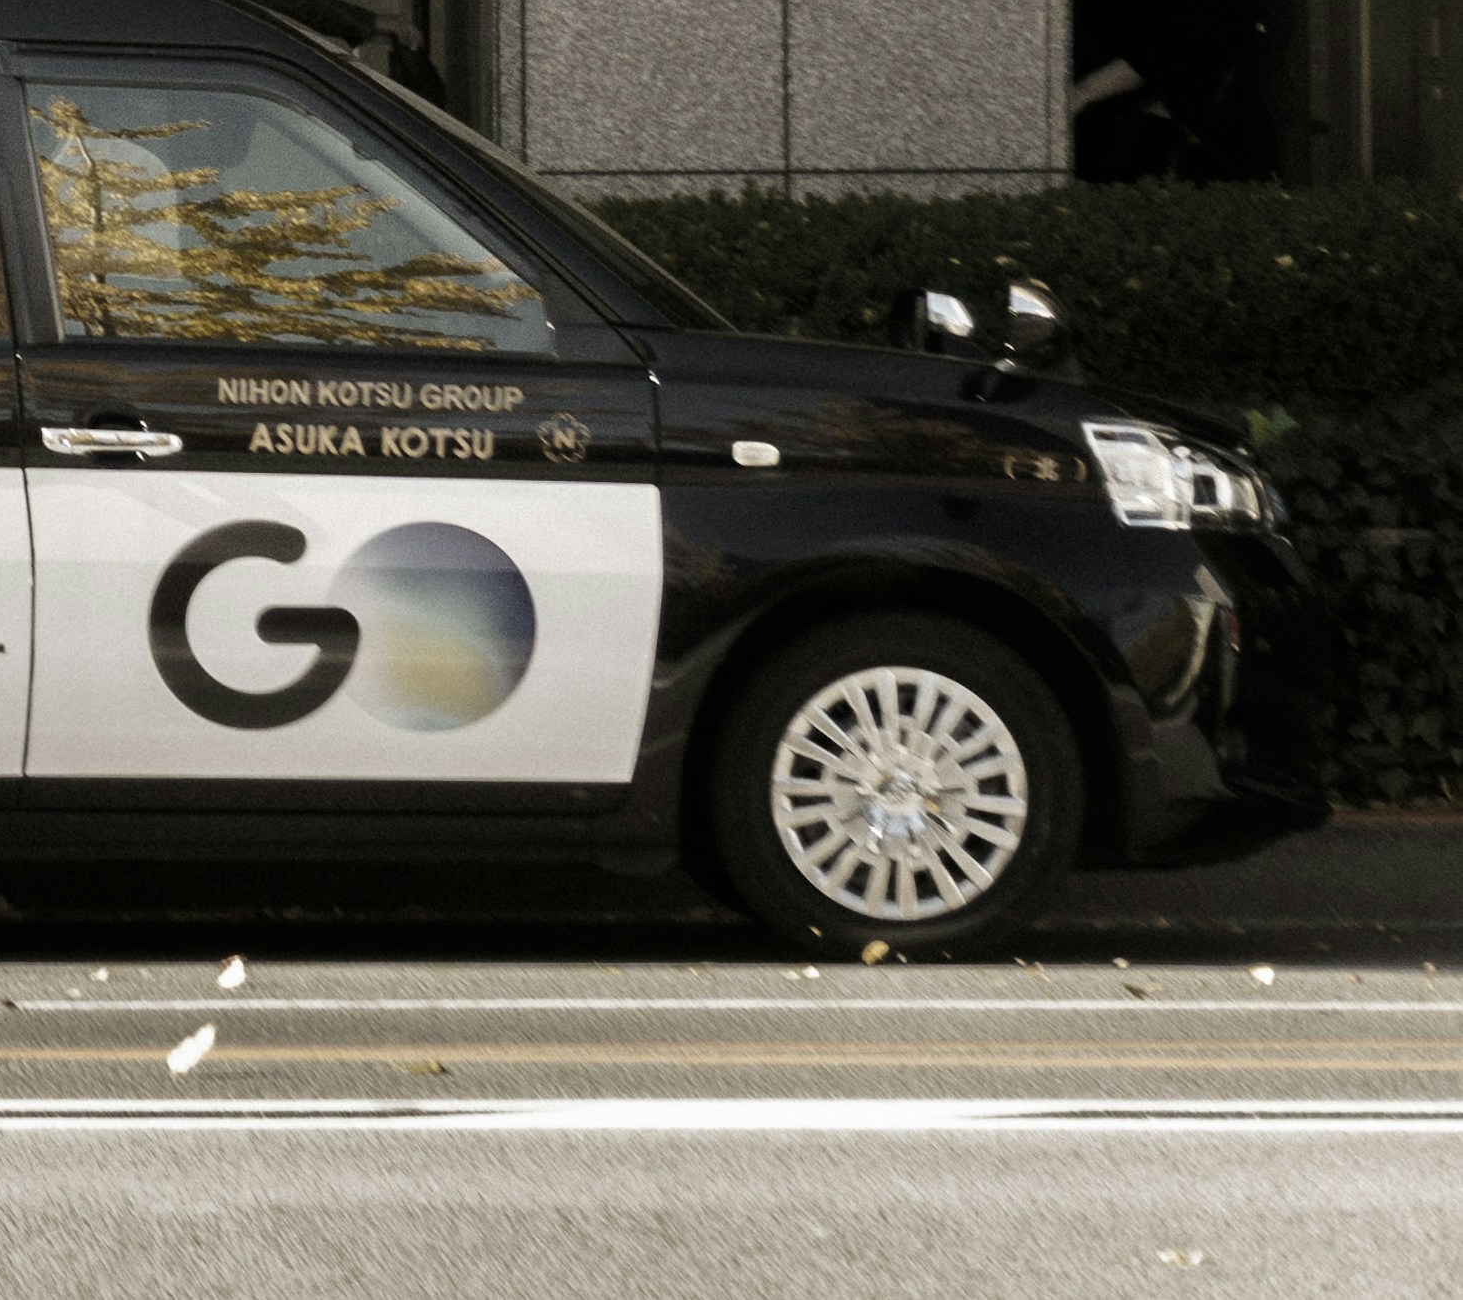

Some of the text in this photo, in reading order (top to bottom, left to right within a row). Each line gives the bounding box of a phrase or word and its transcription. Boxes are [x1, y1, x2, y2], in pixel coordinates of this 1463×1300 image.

[218, 377, 524, 412] NIHON KOTSU GROUP
[249, 422, 495, 461] ASUKA KOTSU
[149, 518, 537, 732] GO
